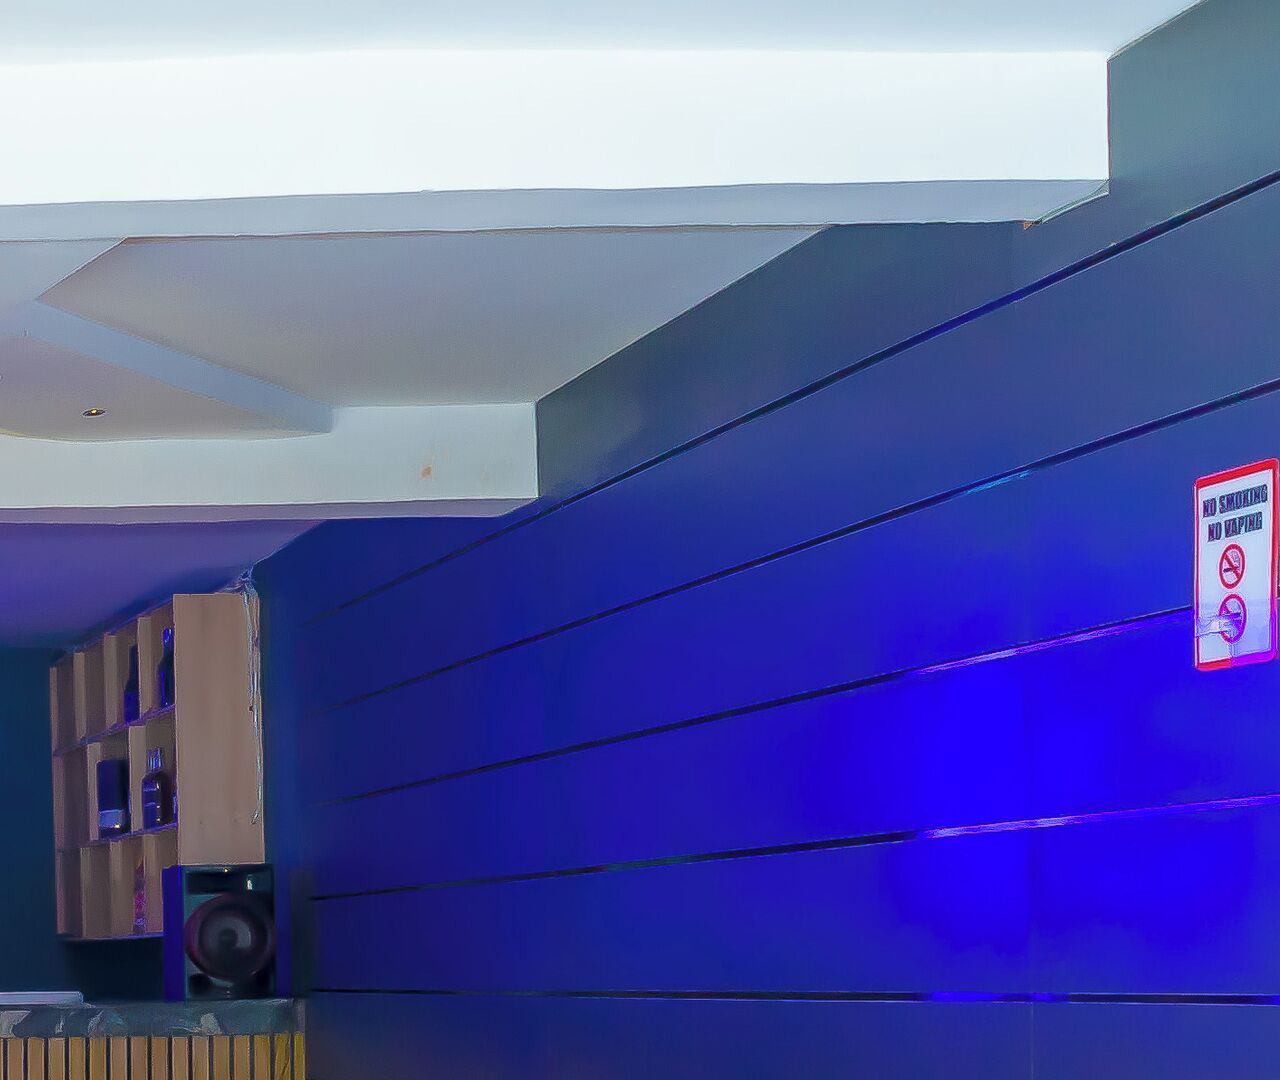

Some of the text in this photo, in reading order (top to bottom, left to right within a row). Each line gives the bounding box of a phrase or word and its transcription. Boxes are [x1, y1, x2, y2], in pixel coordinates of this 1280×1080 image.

[1202, 484, 1268, 518] NO SMOKING
[1207, 511, 1263, 542] NO VAPING
